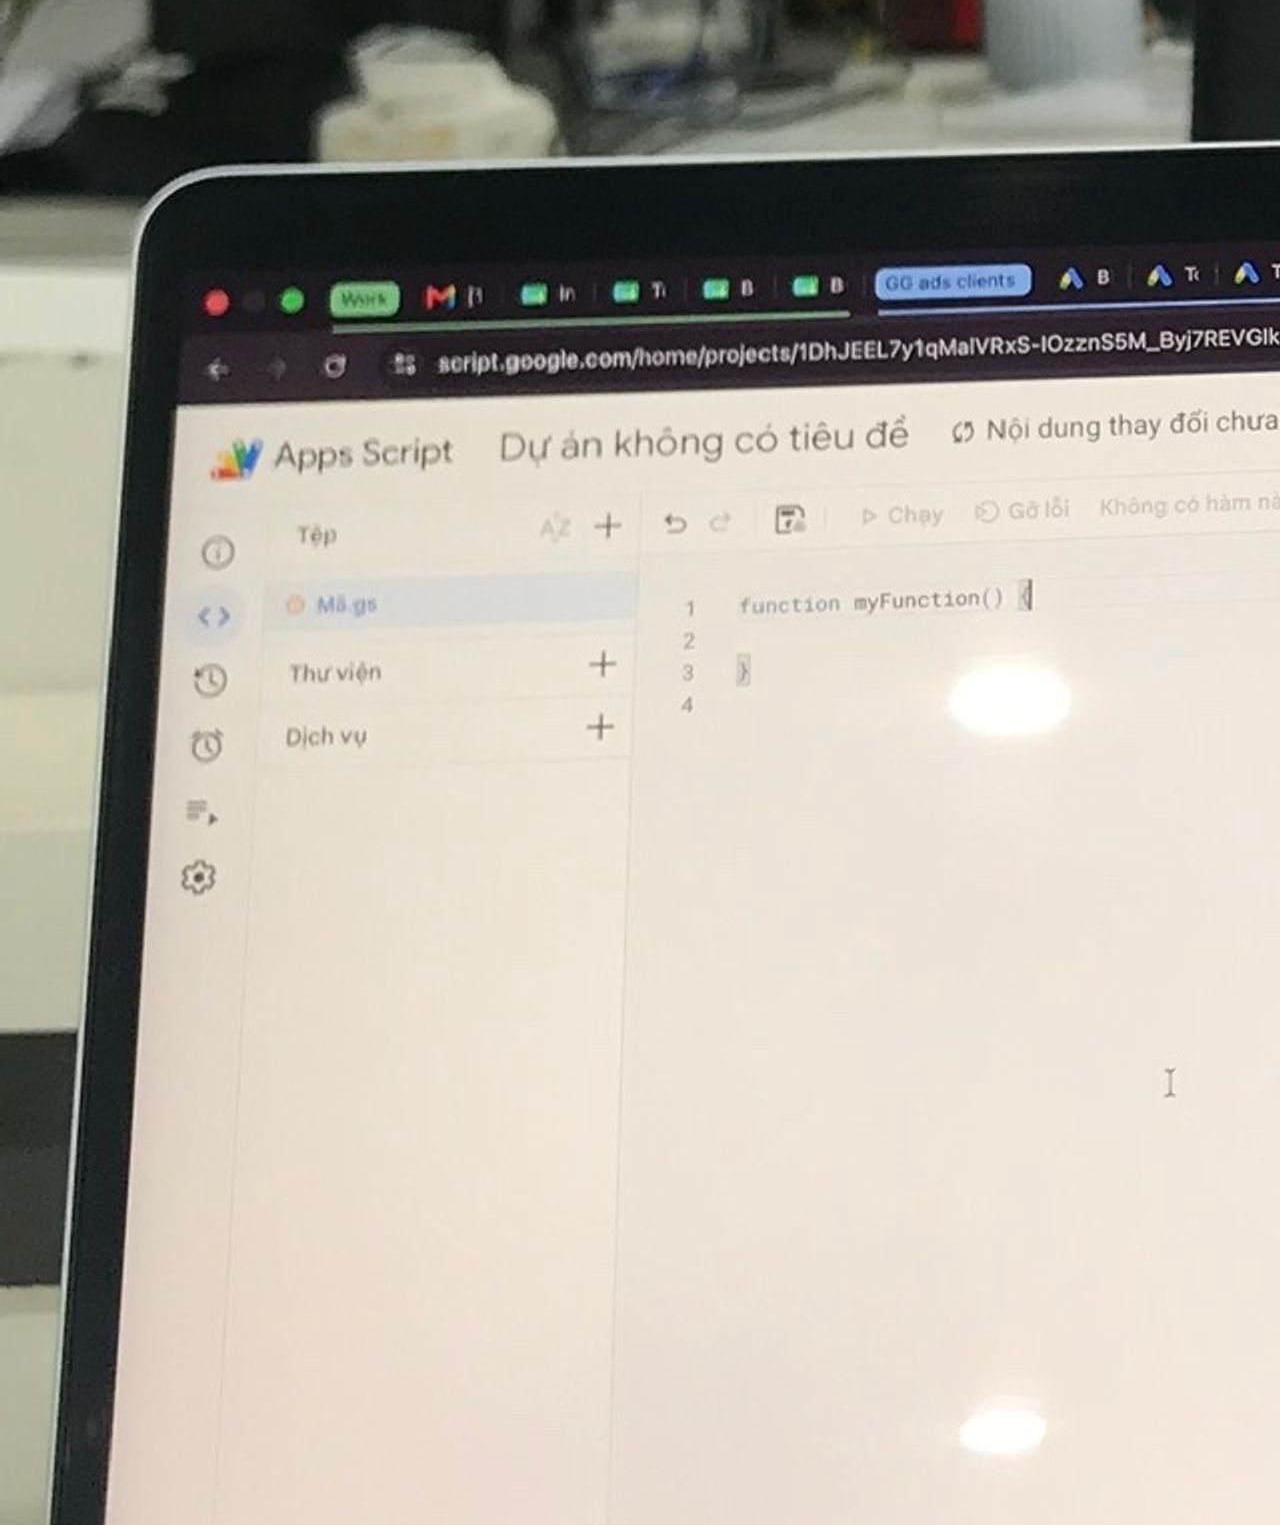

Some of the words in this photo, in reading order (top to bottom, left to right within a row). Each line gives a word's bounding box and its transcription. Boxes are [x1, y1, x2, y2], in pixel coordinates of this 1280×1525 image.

[919, 273, 951, 291] ads
[957, 270, 1016, 290] clients
[987, 417, 1030, 446] Nội
[1038, 416, 1101, 443] dung
[1109, 413, 1161, 440] thay
[1216, 409, 1279, 432] chưa
[500, 430, 552, 468] Dự
[561, 428, 603, 461] án
[614, 426, 725, 463] không
[734, 422, 779, 454] có
[790, 421, 855, 452] tiêu
[866, 414, 910, 449] đề
[275, 440, 353, 474] Apps
[363, 436, 453, 470] Script
[888, 504, 944, 528] Chạy
[1100, 497, 1168, 518] Không
[297, 525, 338, 548] Tệp
[685, 600, 694, 617] 1
[740, 596, 841, 615] function
[854, 587, 1003, 615] myFunction()
[683, 632, 696, 651] 2
[291, 662, 332, 683] Thư
[337, 661, 382, 685] viện
[682, 664, 694, 682] 3
[681, 696, 694, 713] 4
[286, 725, 335, 750] Dịch
[341, 729, 368, 749] vụ
